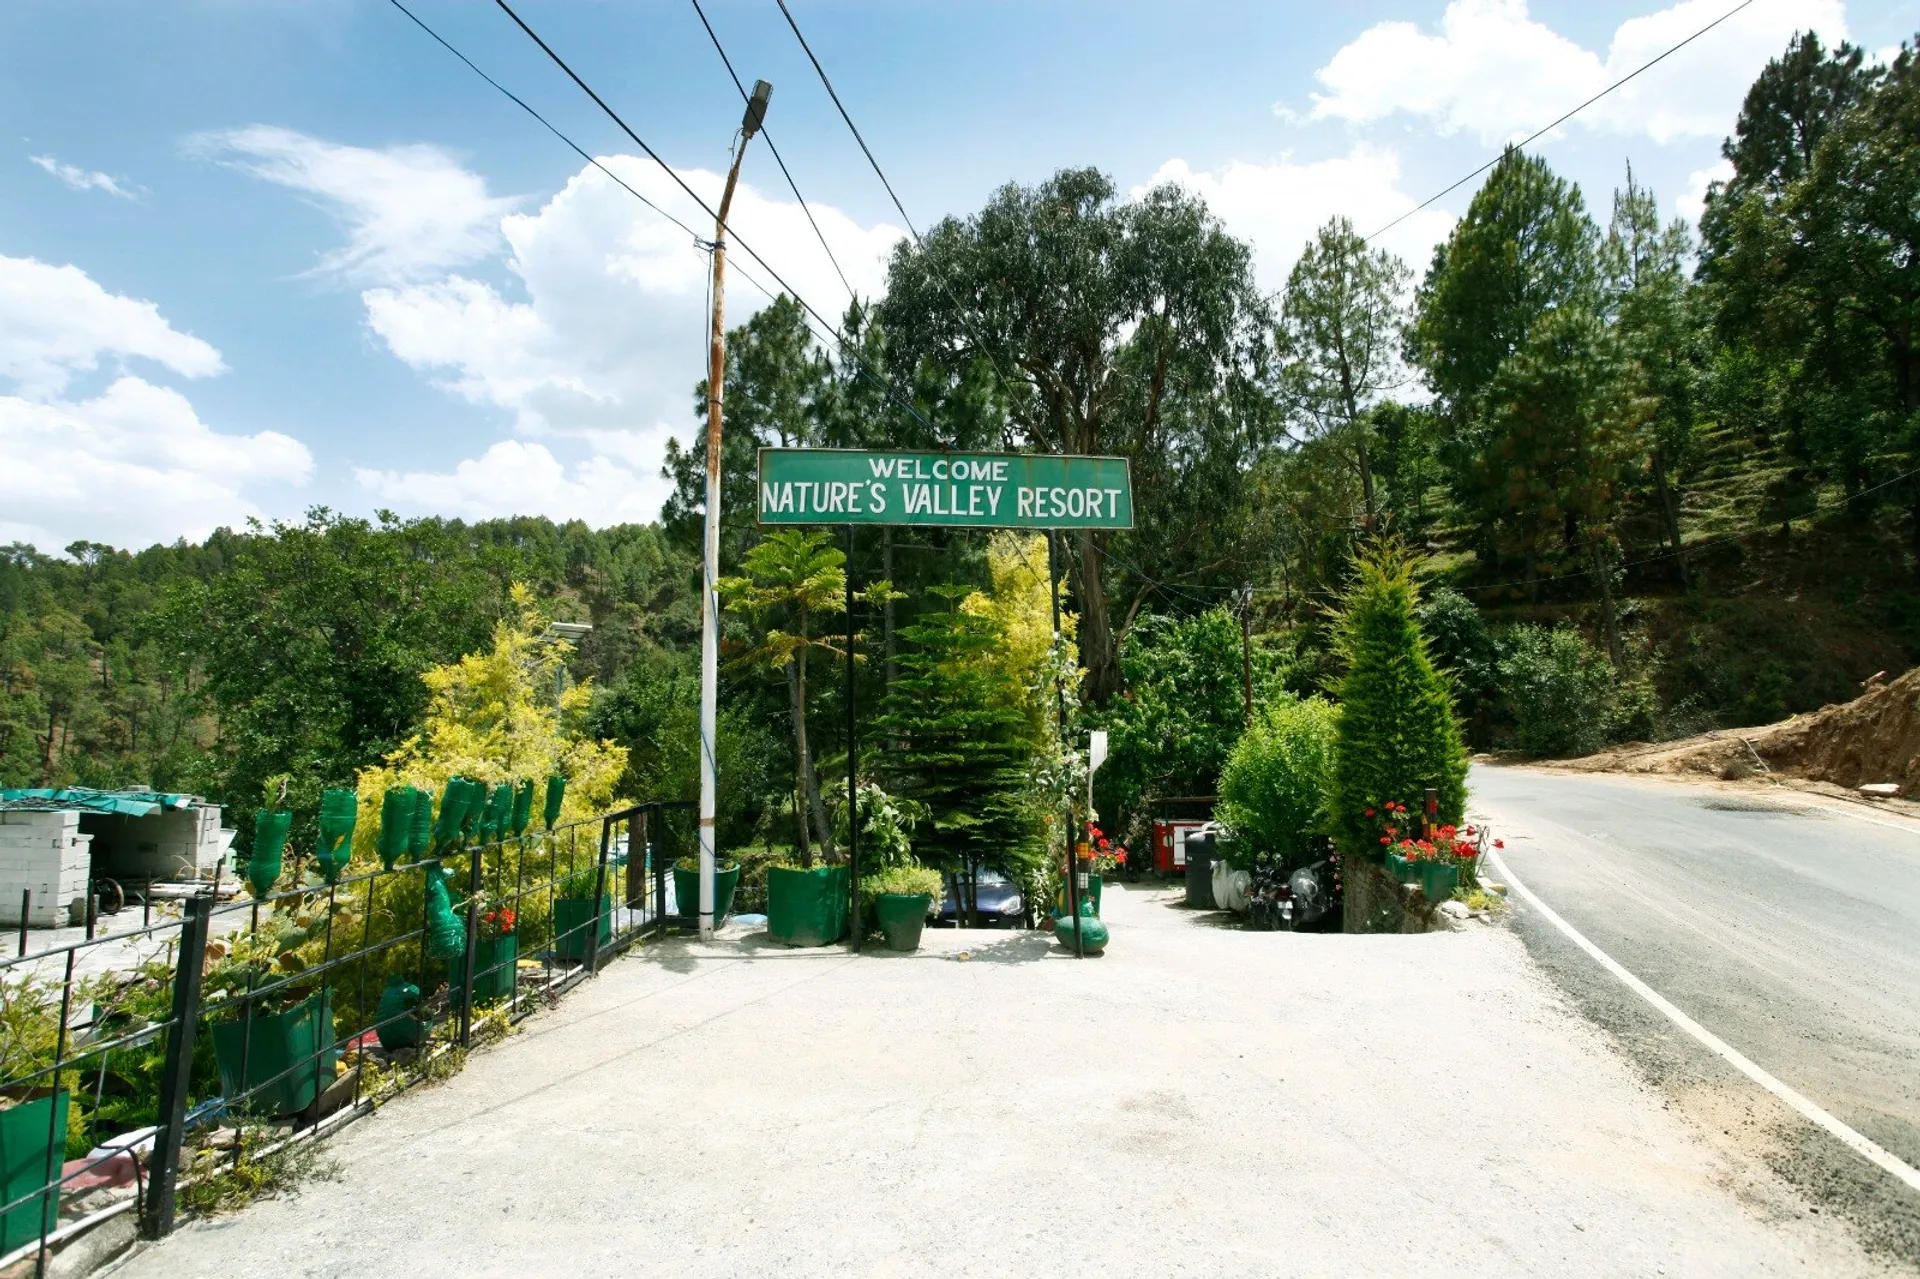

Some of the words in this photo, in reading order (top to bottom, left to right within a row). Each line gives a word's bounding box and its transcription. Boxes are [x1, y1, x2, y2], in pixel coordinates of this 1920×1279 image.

[868, 458, 1008, 481] WELCOME
[762, 479, 887, 514] NATURE'S
[903, 482, 1003, 516] VALLEY
[1017, 486, 1122, 518] RESORT
